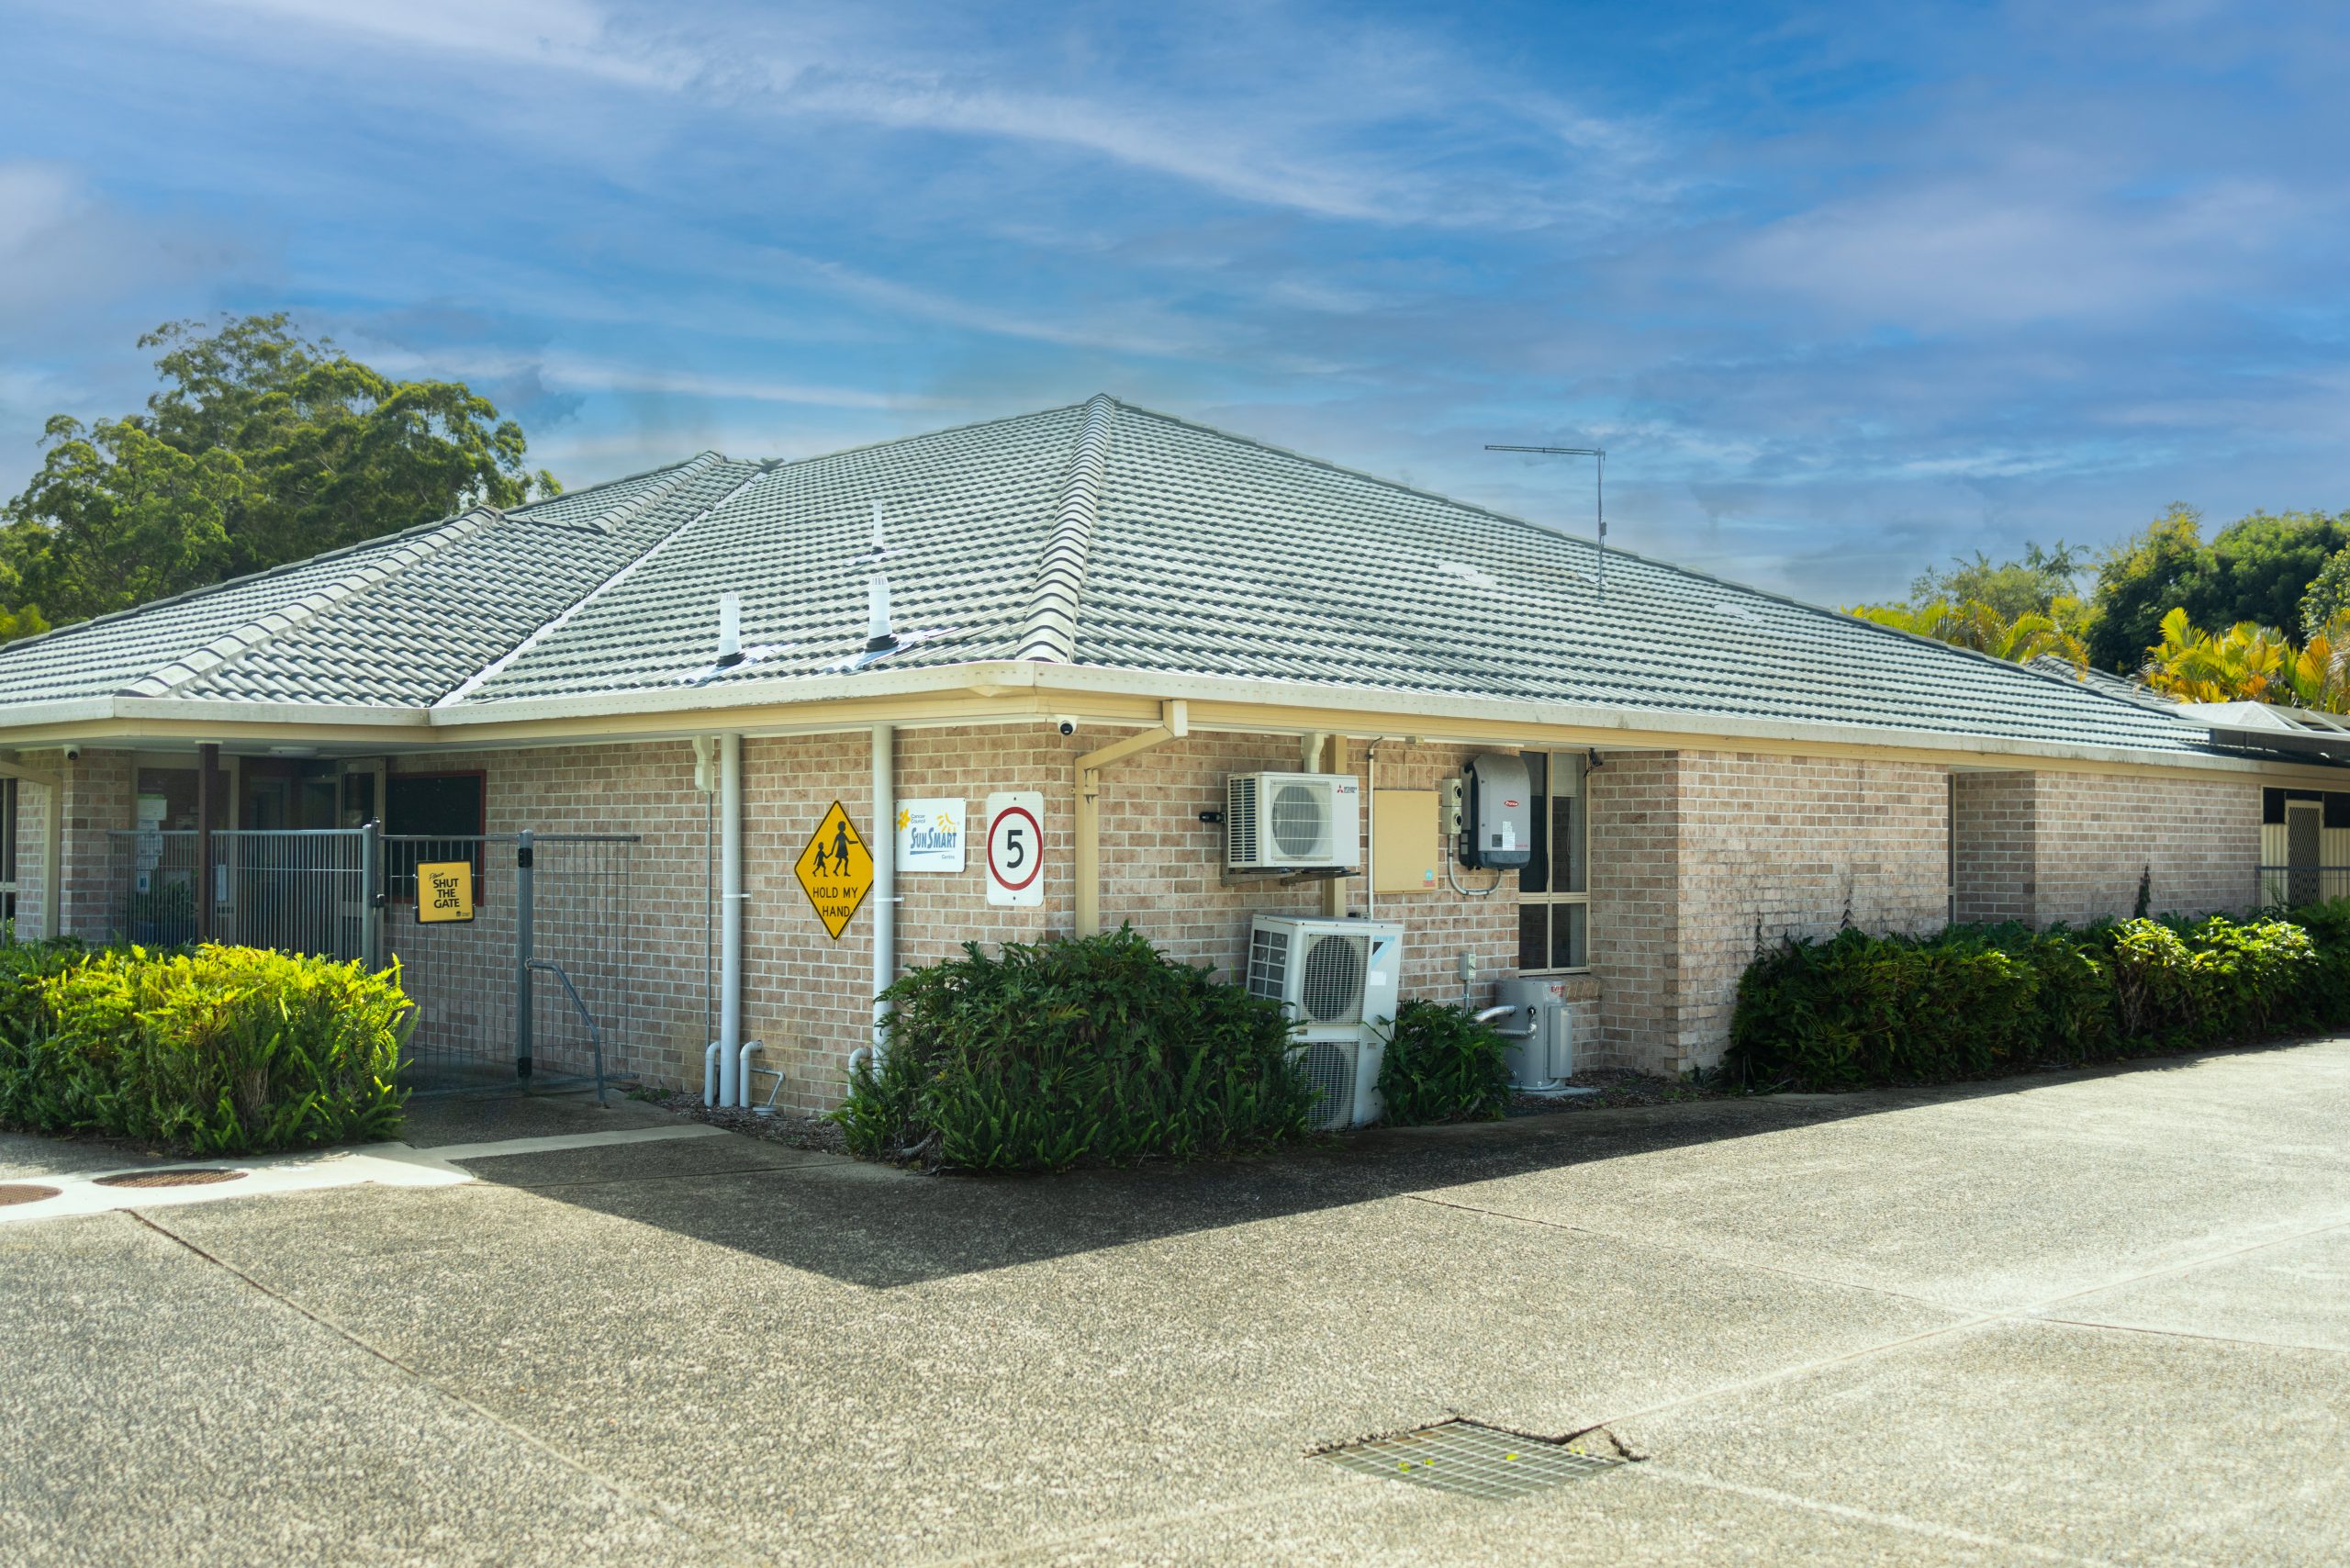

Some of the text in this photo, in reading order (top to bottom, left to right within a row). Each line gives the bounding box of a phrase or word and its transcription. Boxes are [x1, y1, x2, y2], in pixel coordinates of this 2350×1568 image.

[1006, 829, 1024, 868] 5
[432, 878, 459, 889] SHUT
[436, 888, 456, 899] THE
[812, 886, 858, 899] HOLD MY
[433, 898, 461, 909] GATE
[822, 904, 851, 918] HAND
